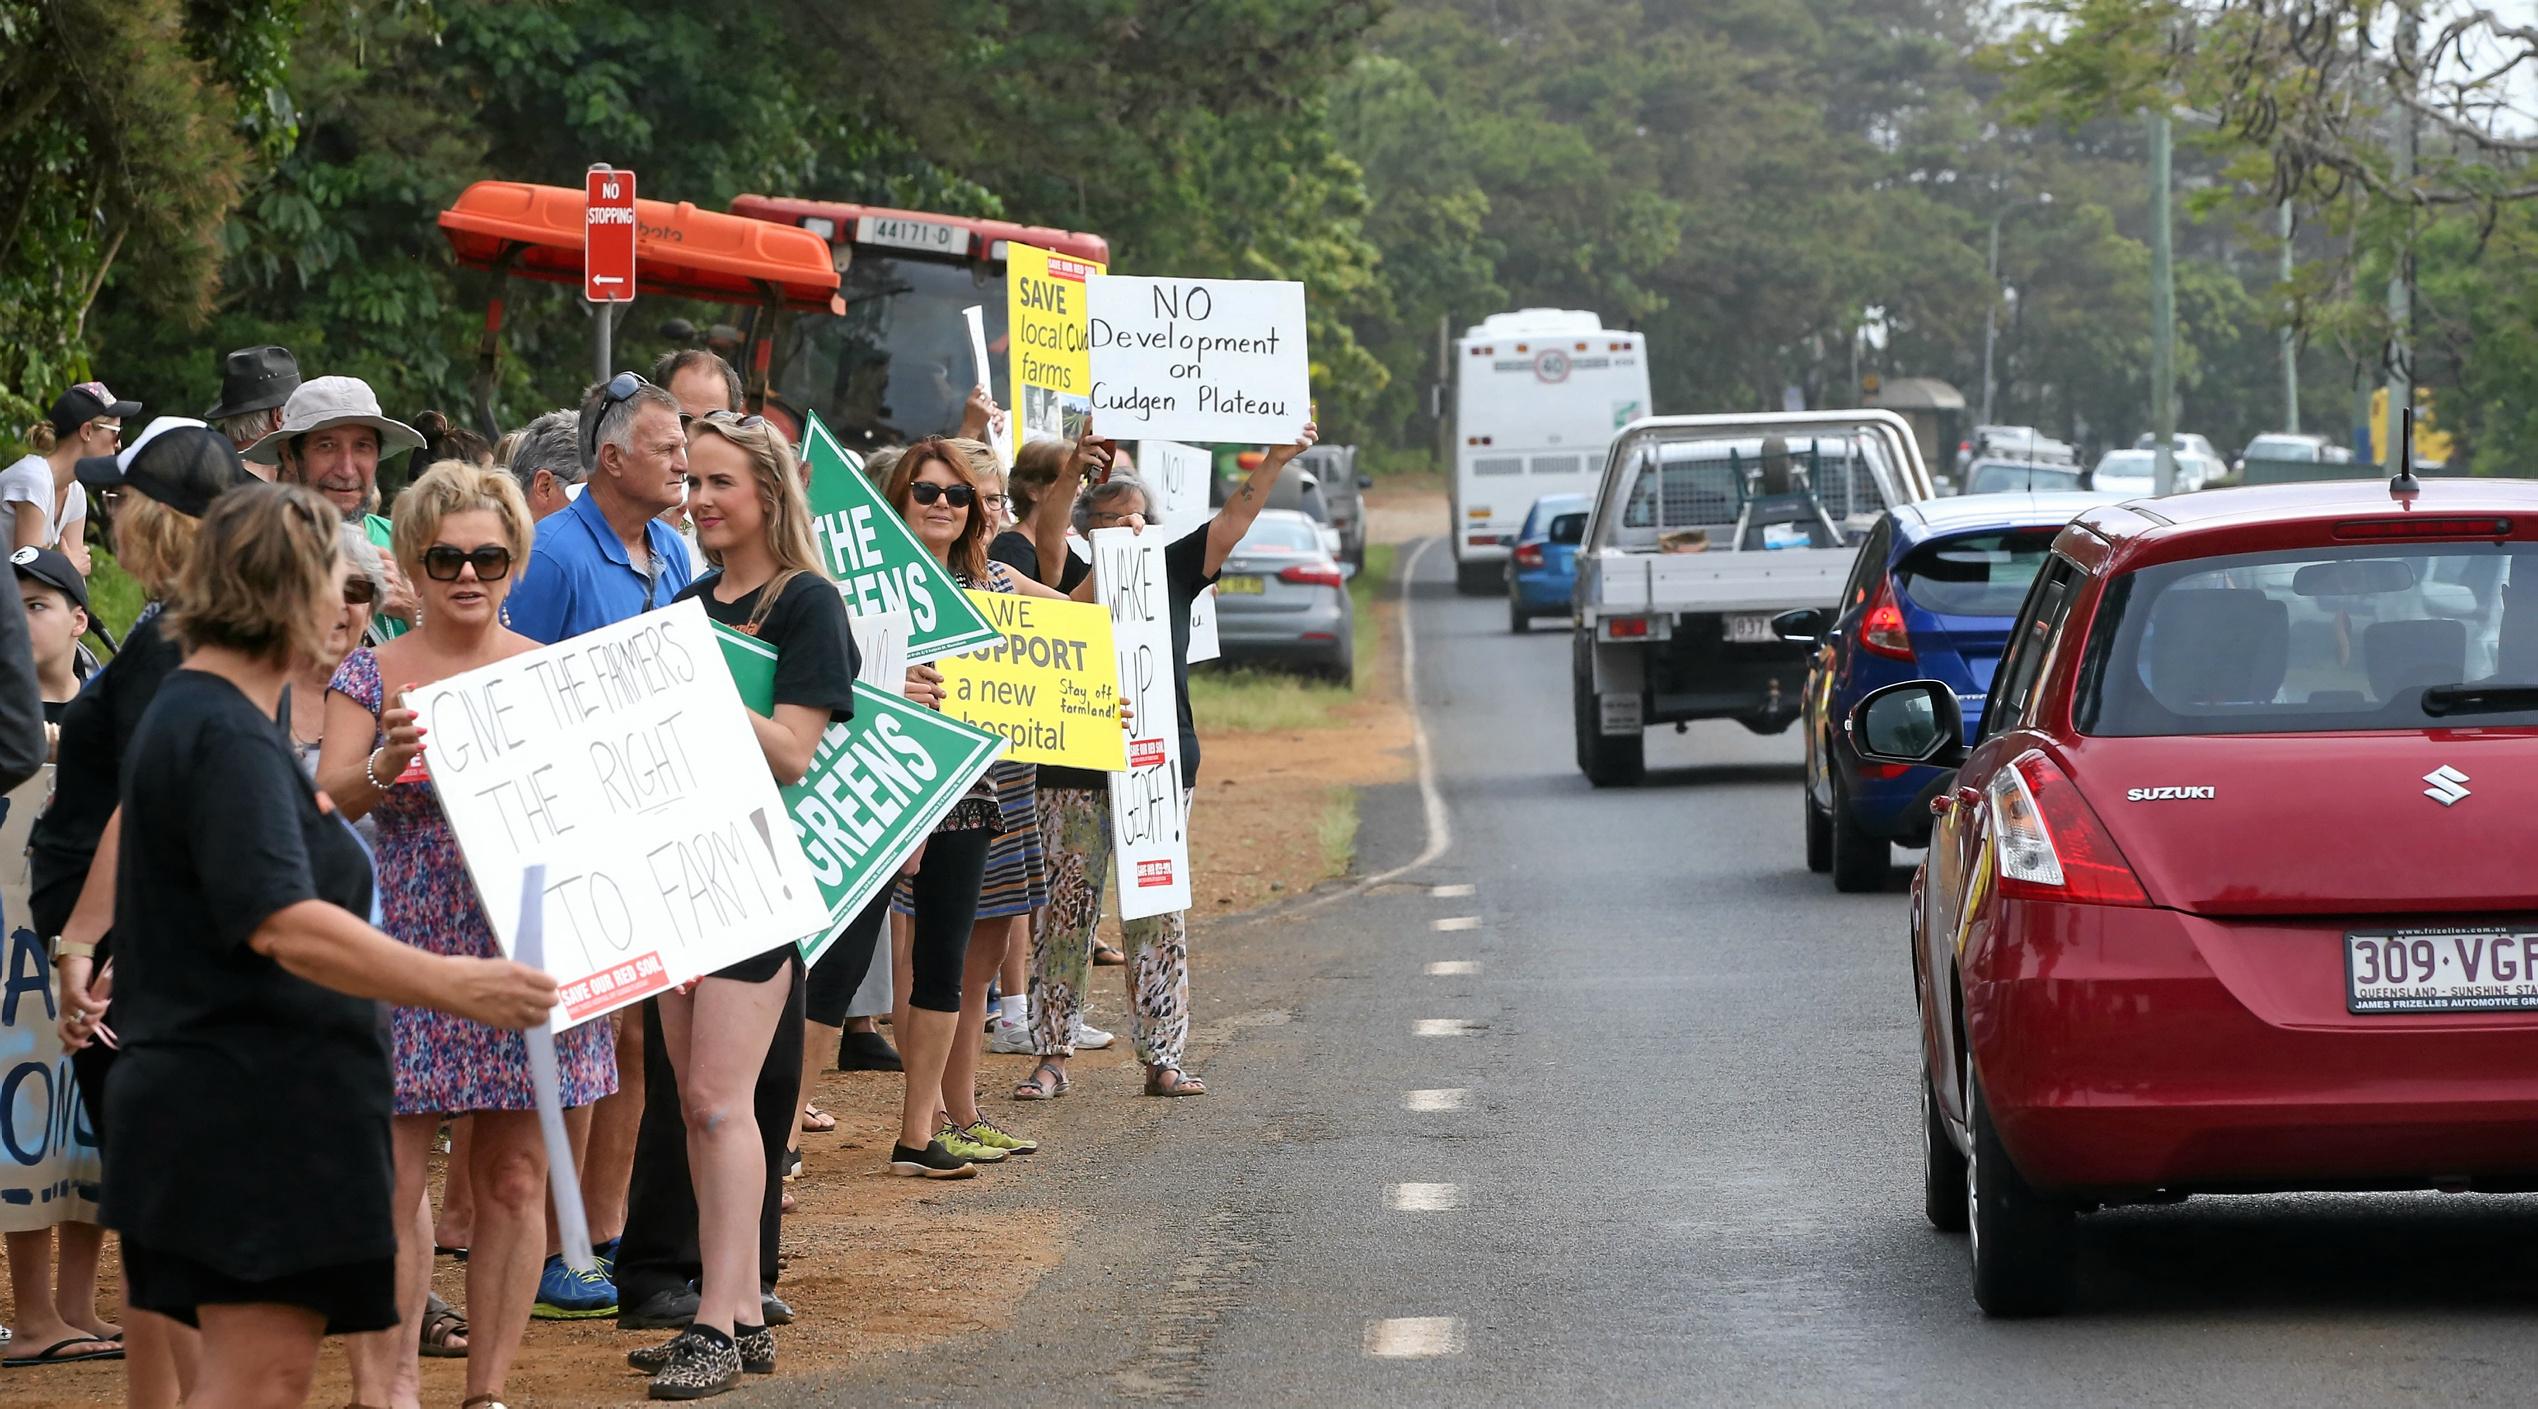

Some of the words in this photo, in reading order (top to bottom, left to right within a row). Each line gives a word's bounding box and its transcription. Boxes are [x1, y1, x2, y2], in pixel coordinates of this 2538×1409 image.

[602, 183, 620, 199] NO
[588, 207, 633, 224] STOPPING
[638, 221, 683, 241] bota
[1020, 276, 1067, 315] SAVE
[1153, 285, 1211, 321] NO
[1020, 314, 1063, 350] local
[1091, 318, 1279, 363] Development
[1022, 351, 1072, 389] farms
[1169, 364, 1202, 379] on
[1091, 381, 1176, 421] Cudgen
[1199, 385, 1289, 417] Plateau.
[1162, 451, 1185, 495] NO!
[812, 504, 884, 575] THE
[1102, 547, 1154, 624] WAKE
[987, 598, 1034, 628] WE
[956, 634, 1087, 672] UPPORT
[432, 680, 526, 773] GIVE
[525, 653, 600, 730] THE
[586, 621, 695, 714] FARMERS
[957, 678, 971, 701] a
[981, 680, 1036, 707] new
[1059, 679, 1087, 704] Stay
[1095, 684, 1112, 701] off
[1120, 645, 1154, 740] UP
[475, 763, 575, 854] THE
[590, 711, 698, 814] RIGHT
[788, 711, 937, 887] GREENS
[2127, 786, 2216, 802] SUZUKI
[543, 872, 633, 972] TO
[2397, 926, 2508, 936] www.frizelles.com.au
[561, 981, 592, 1006] SAVE
[589, 974, 615, 996] OUR
[612, 965, 637, 987] RED
[635, 955, 663, 978] SOIL
[2360, 987, 2438, 998] QUEENSLAND
[2450, 985, 2510, 997] SUNSHINE
[2356, 1000, 2391, 1010] JAMES
[2393, 999, 2448, 1009] FRIZELLES
[2451, 998, 2519, 1007] AUTOMOTIVE
